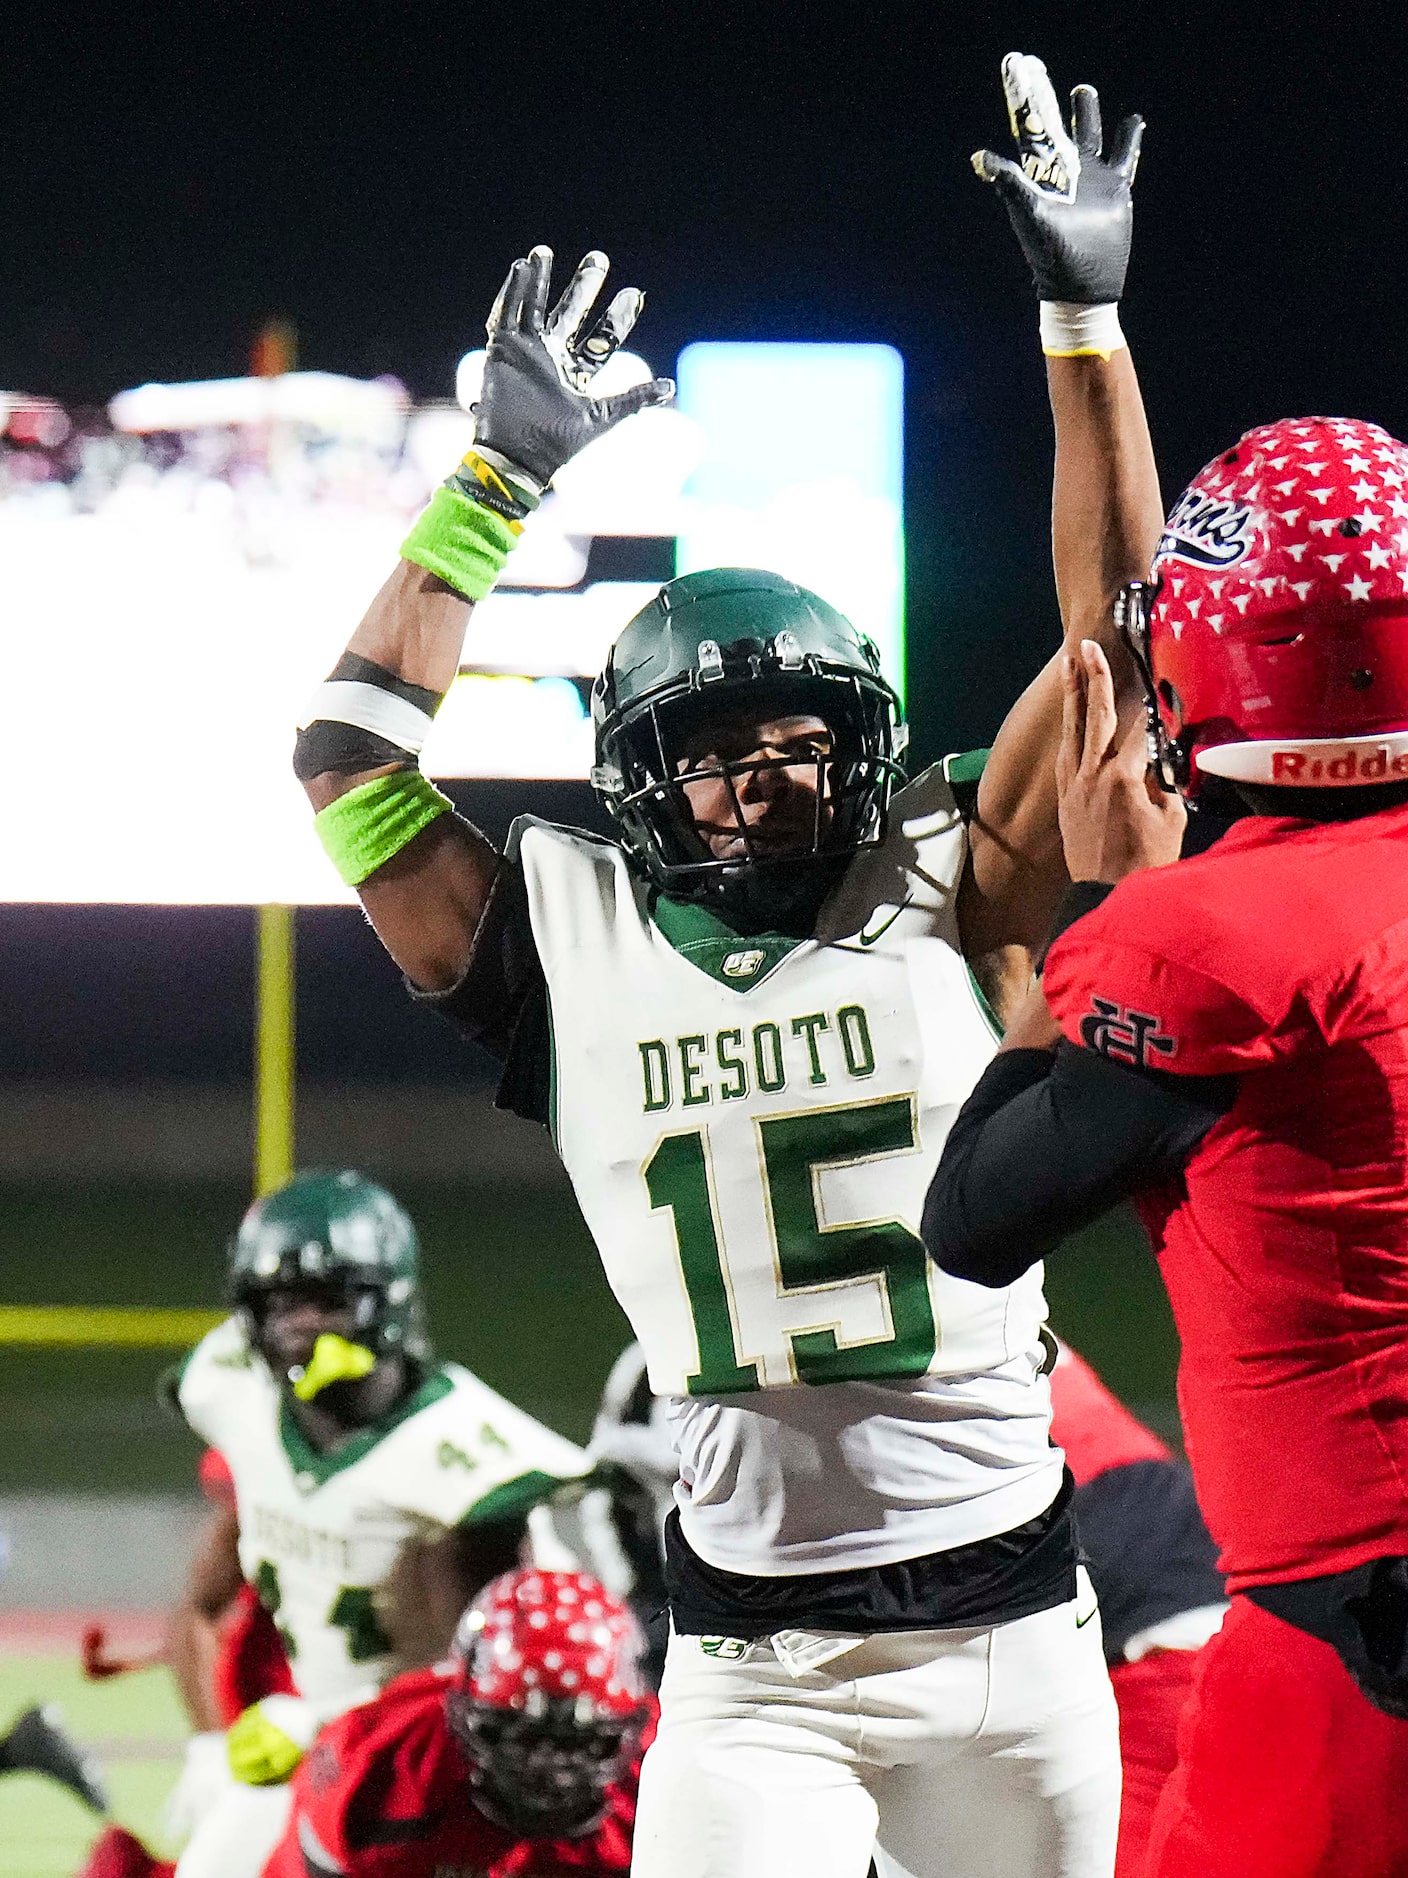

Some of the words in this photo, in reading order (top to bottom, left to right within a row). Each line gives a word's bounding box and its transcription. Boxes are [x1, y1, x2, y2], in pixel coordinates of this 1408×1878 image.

[637, 1003, 878, 1114] DESOTO
[639, 1091, 942, 1396] 15
[437, 1421, 511, 1472] 44
